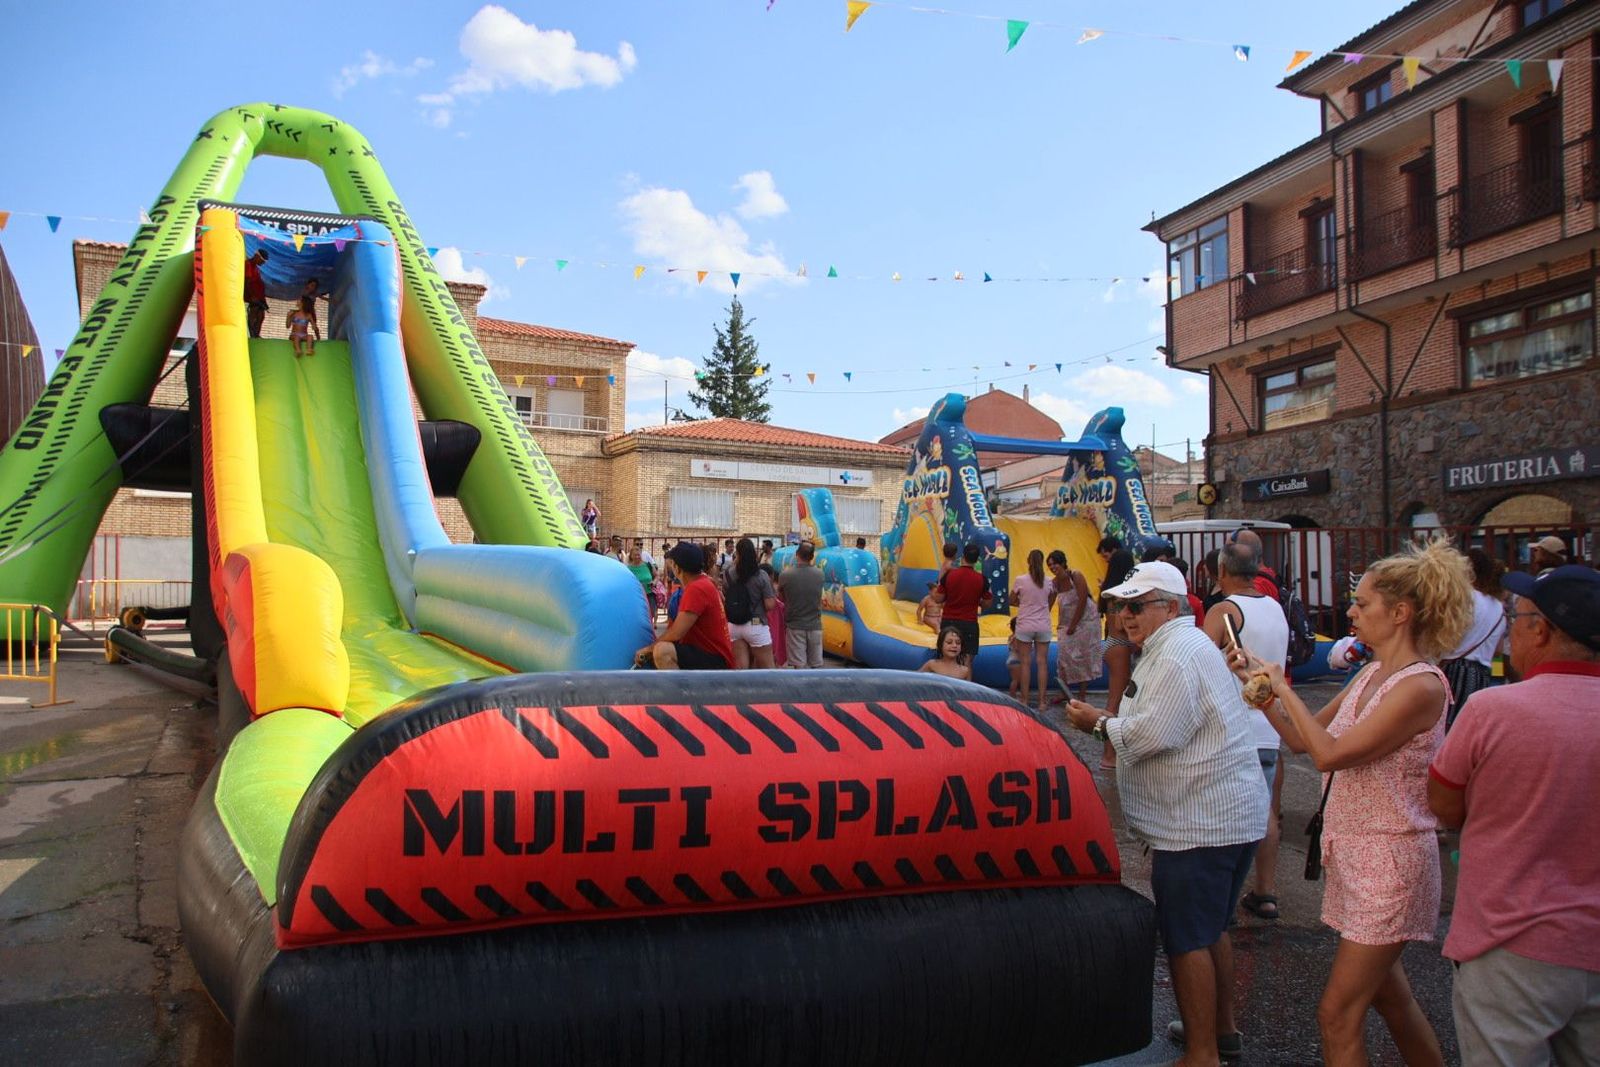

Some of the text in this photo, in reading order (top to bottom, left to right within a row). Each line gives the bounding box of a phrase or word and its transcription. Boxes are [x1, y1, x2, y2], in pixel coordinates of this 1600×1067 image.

[286, 222, 340, 236] SPLA
[14, 195, 176, 450] AGILITY NOT FOUND
[387, 200, 584, 538] DANGEROUS DO NOT ENTER
[962, 466, 978, 491] SEA
[1271, 476, 1309, 492] CaixaBank
[1449, 456, 1561, 487] FRUTERIA
[1128, 480, 1143, 502] SEA
[403, 766, 1072, 857] MULTI SPLASH
